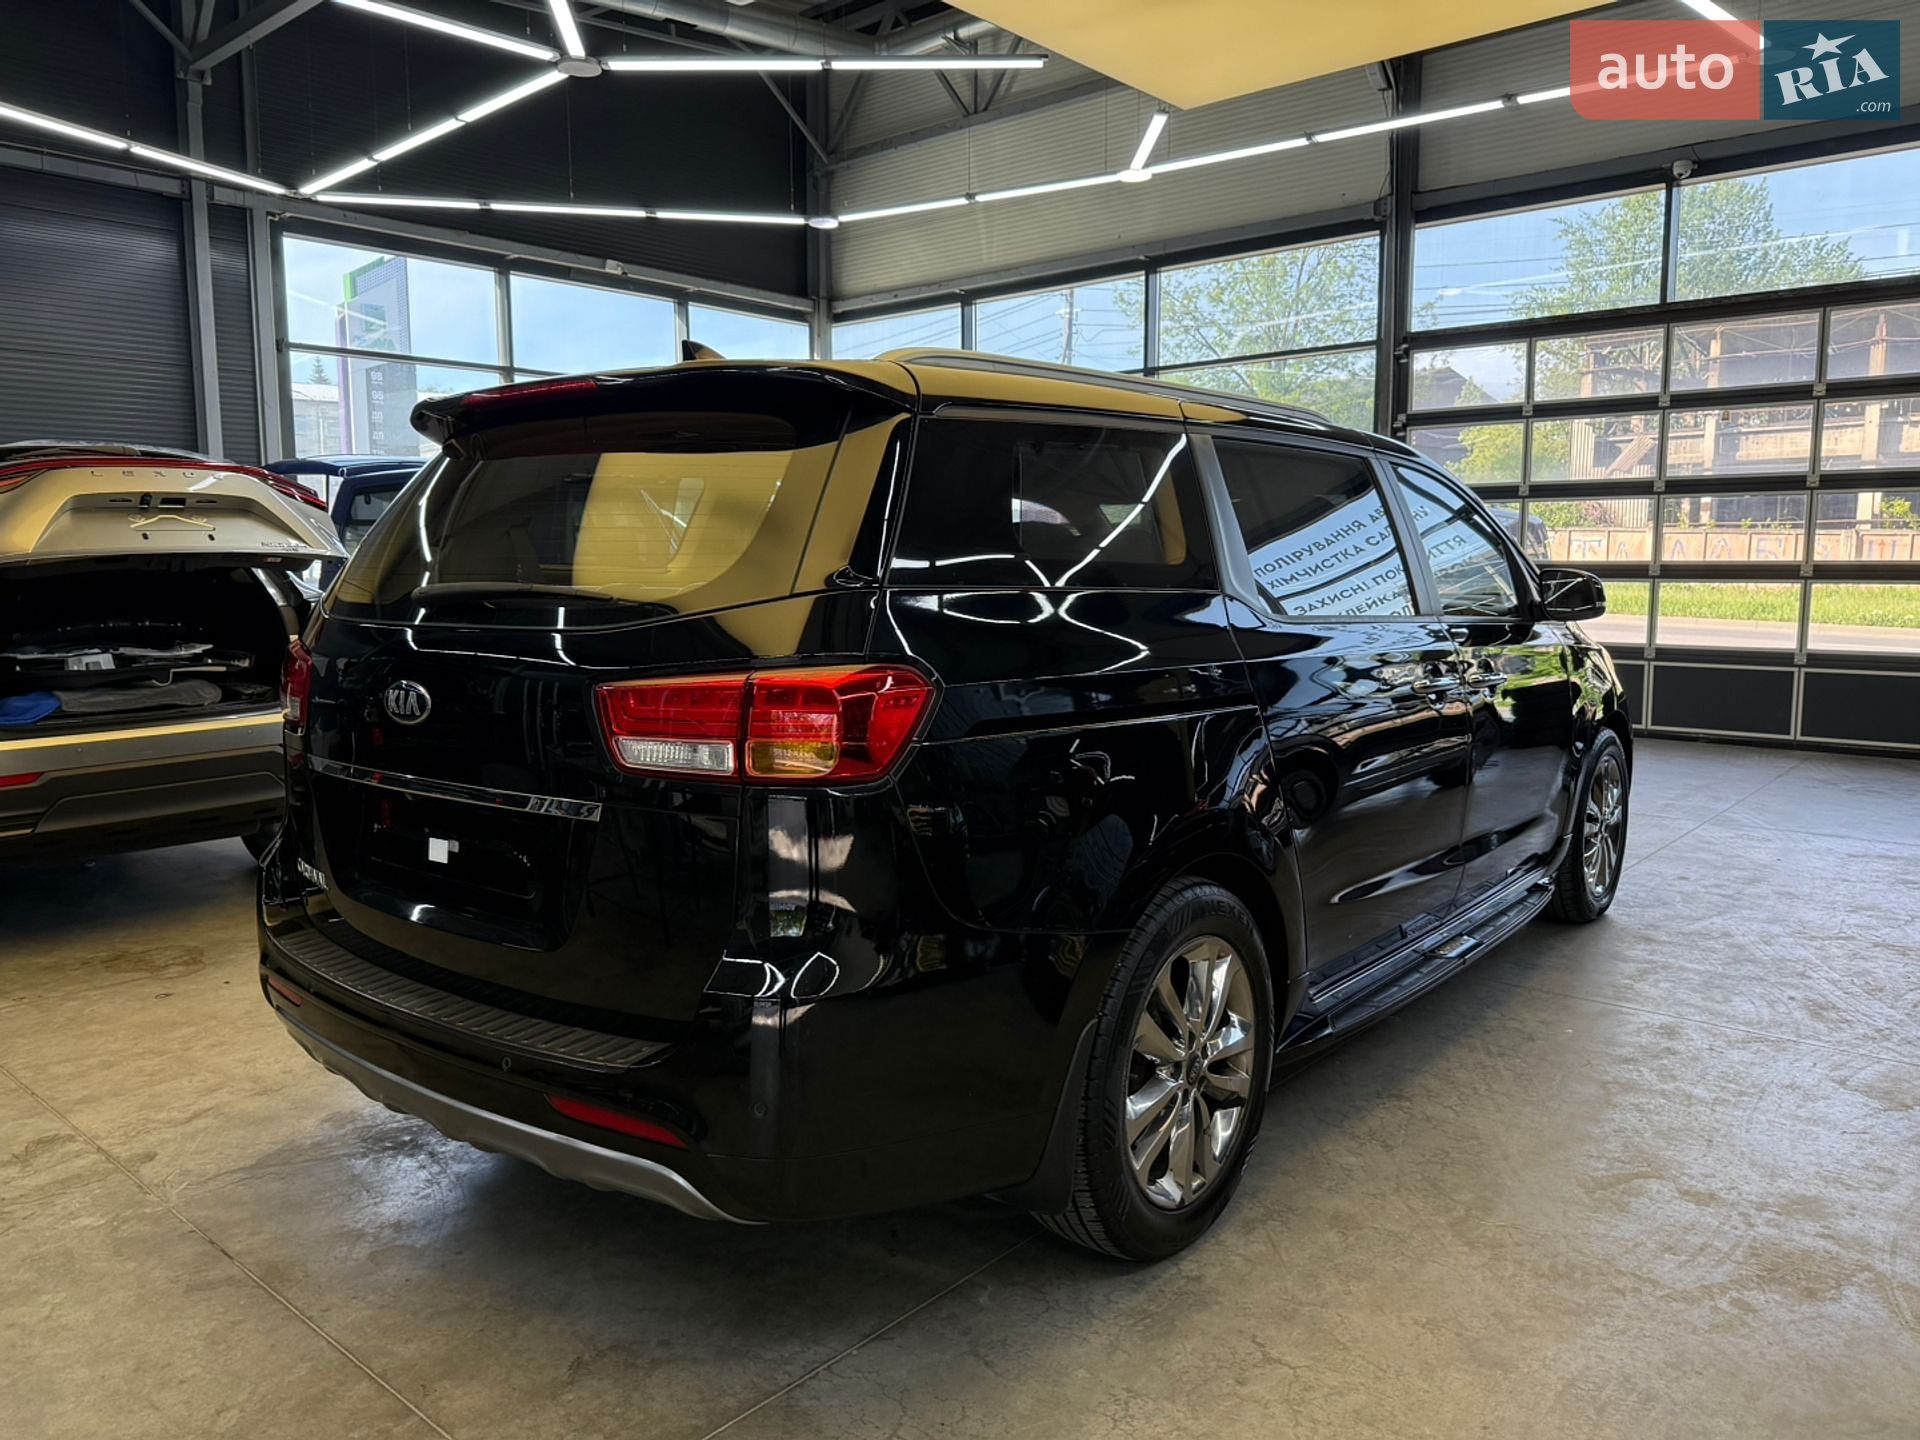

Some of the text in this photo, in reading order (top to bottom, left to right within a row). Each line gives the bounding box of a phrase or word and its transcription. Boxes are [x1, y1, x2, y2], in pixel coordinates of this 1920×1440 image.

[1254, 519, 1367, 577] ПОЛІРУВАННЯ
[1266, 544, 1365, 589] ХІМЧИСТКА
[1294, 581, 1370, 616] ЗАХИСНІ
[388, 689, 421, 716] KIA
